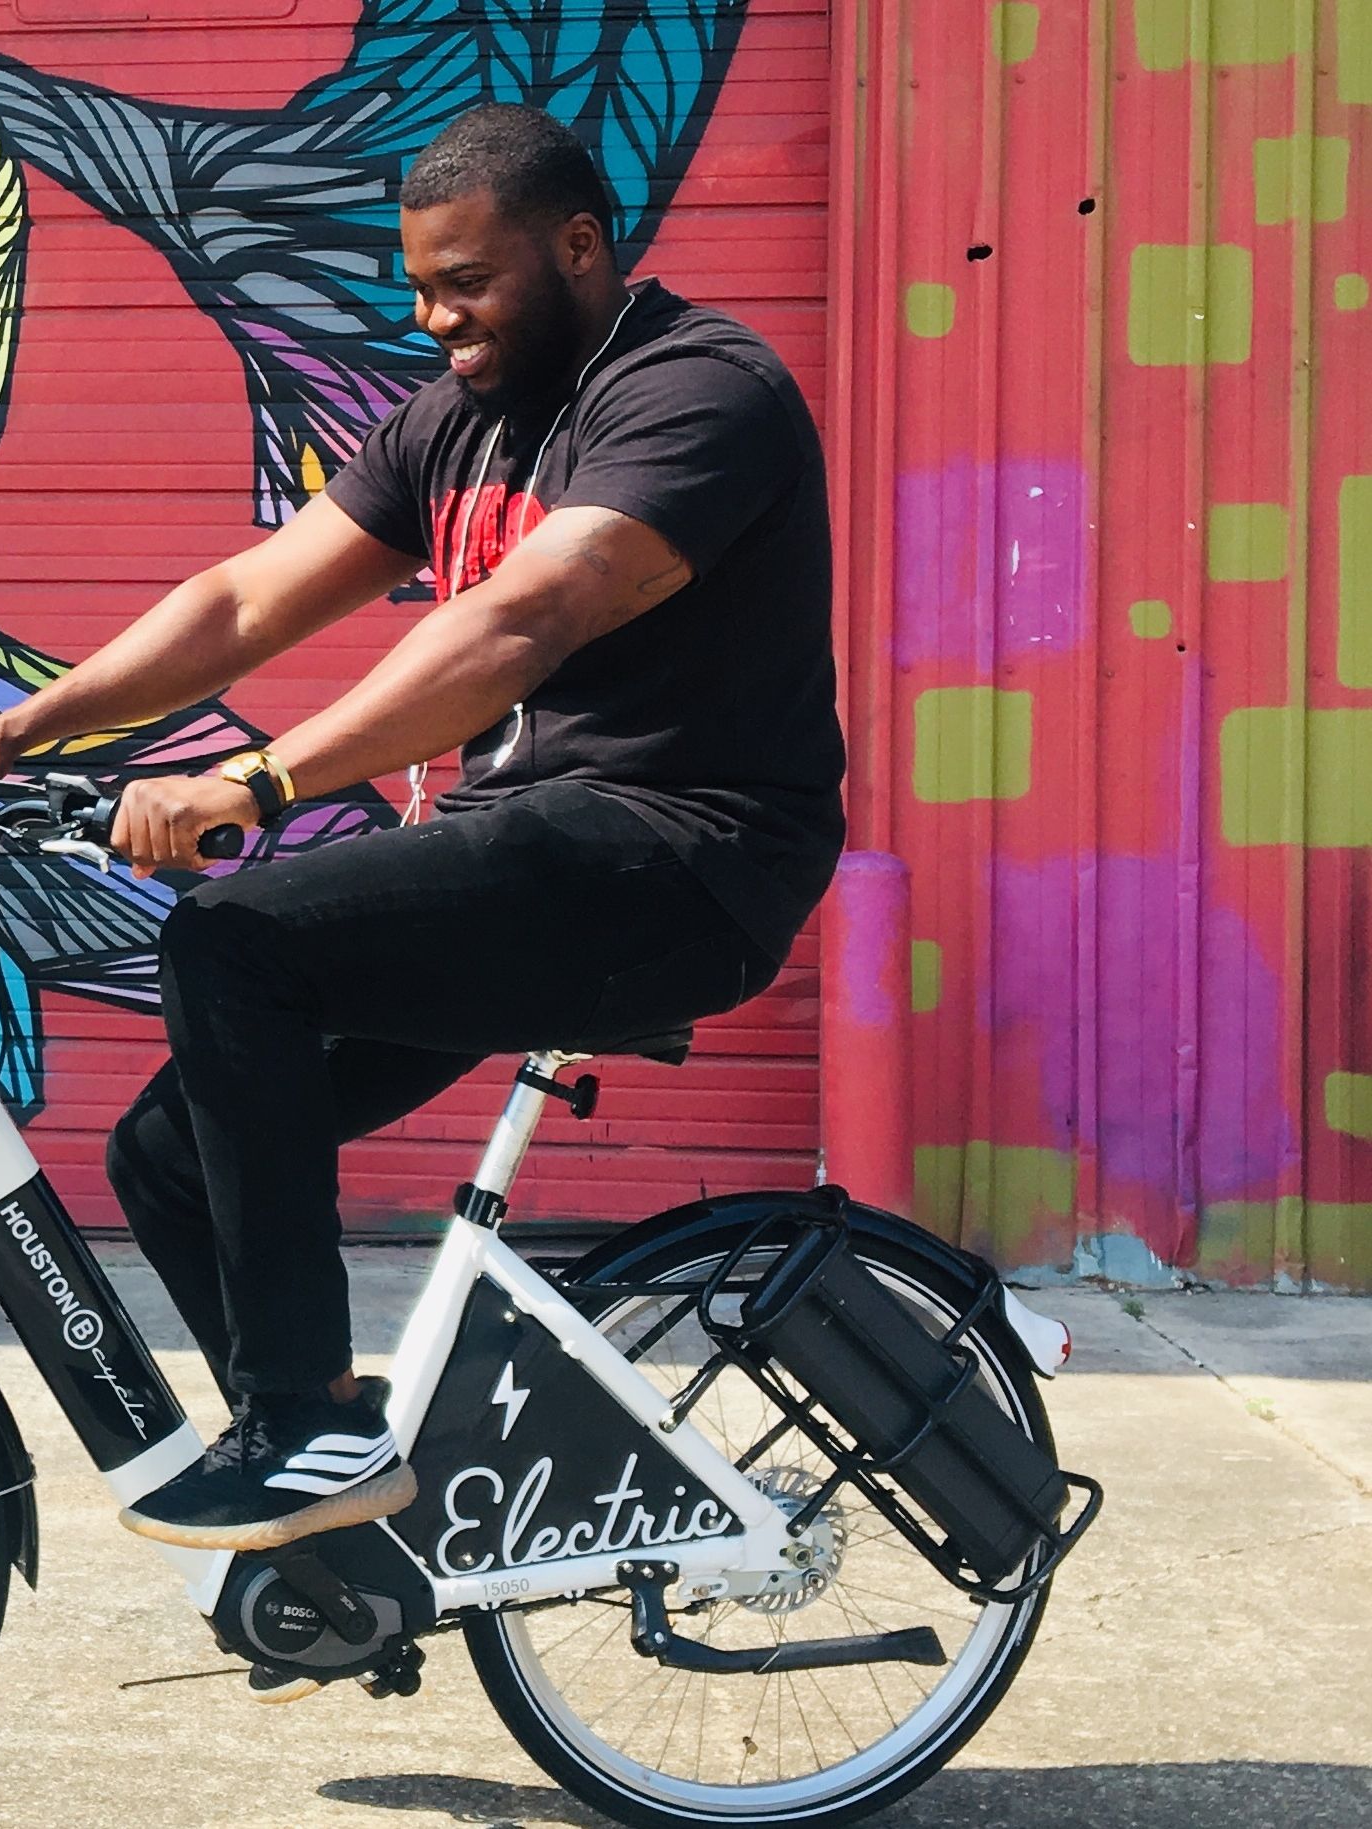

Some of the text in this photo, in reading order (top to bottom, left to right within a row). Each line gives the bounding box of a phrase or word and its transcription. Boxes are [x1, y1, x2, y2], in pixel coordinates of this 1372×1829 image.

[0, 1200, 80, 1316] HOUSTON
[436, 1452, 733, 1577] Electric
[483, 1577, 530, 1598] 15050
